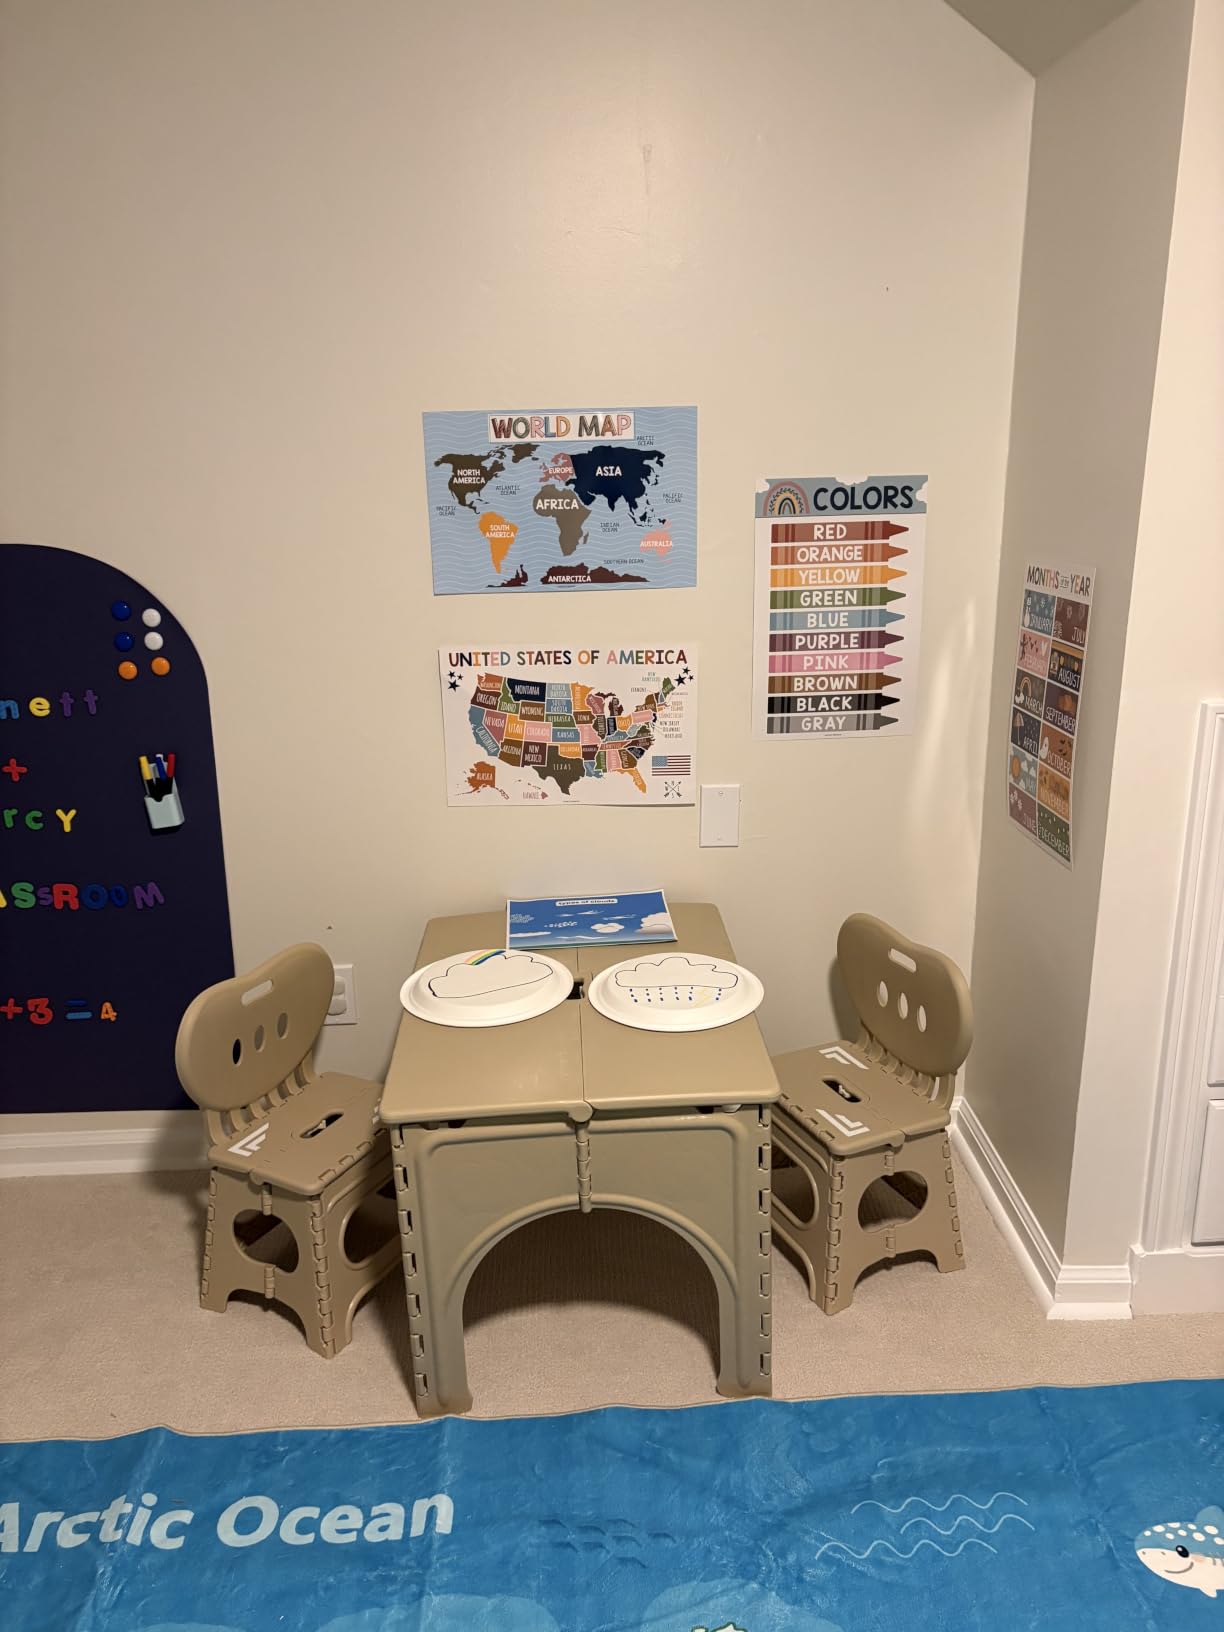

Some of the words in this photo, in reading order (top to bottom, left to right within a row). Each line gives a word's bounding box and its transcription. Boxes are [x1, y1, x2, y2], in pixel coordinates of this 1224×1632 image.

[491, 415, 571, 439] WORLD
[578, 414, 632, 437] MAP
[457, 468, 481, 476] NORTH
[595, 466, 622, 477] ASIA
[453, 476, 486, 484] AMERICA
[535, 498, 579, 510] AFRICA
[813, 485, 914, 511] COLORS
[813, 524, 847, 540] RED
[640, 540, 673, 548] AUSTRALIA
[796, 546, 864, 562] ORANGE
[548, 575, 592, 583] ANTARCTICA
[799, 568, 860, 585] YELLOW
[1026, 565, 1060, 589] MONTHS
[1070, 573, 1091, 597] YEAR
[800, 590, 857, 606] GREEN
[807, 612, 849, 628] BLUE
[795, 633, 859, 650] PURPLE
[449, 651, 511, 667] UNITED
[517, 650, 572, 666] STATES
[578, 650, 600, 665] OF
[606, 649, 688, 665] AMERICA
[803, 655, 849, 670] PINK
[793, 675, 858, 692] BROWN
[1058, 667, 1080, 689] AUGUST
[514, 684, 540, 696] MONTANA
[476, 693, 498, 706] OREGON
[501, 701, 517, 712] IDAHO
[796, 696, 852, 712] BLACK
[1024, 695, 1043, 716] MARCH
[521, 705, 544, 716] WYOMING
[485, 717, 505, 728] NEVADA
[801, 716, 847, 731] GRAY
[1045, 706, 1076, 732] SEPTEMBER
[508, 723, 523, 734] UTAH
[475, 725, 498, 753] CALIFORNIA
[1023, 736, 1038, 756] APRIL
[502, 745, 522, 756] ARIZONA
[528, 745, 539, 753] NEW
[524, 754, 542, 763] MEXICO
[1047, 750, 1072, 776] OCTOBER
[553, 763, 571, 771] TEXAS
[1041, 826, 1070, 857] DECEMBER
[216, 1493, 455, 1548] Ocean
